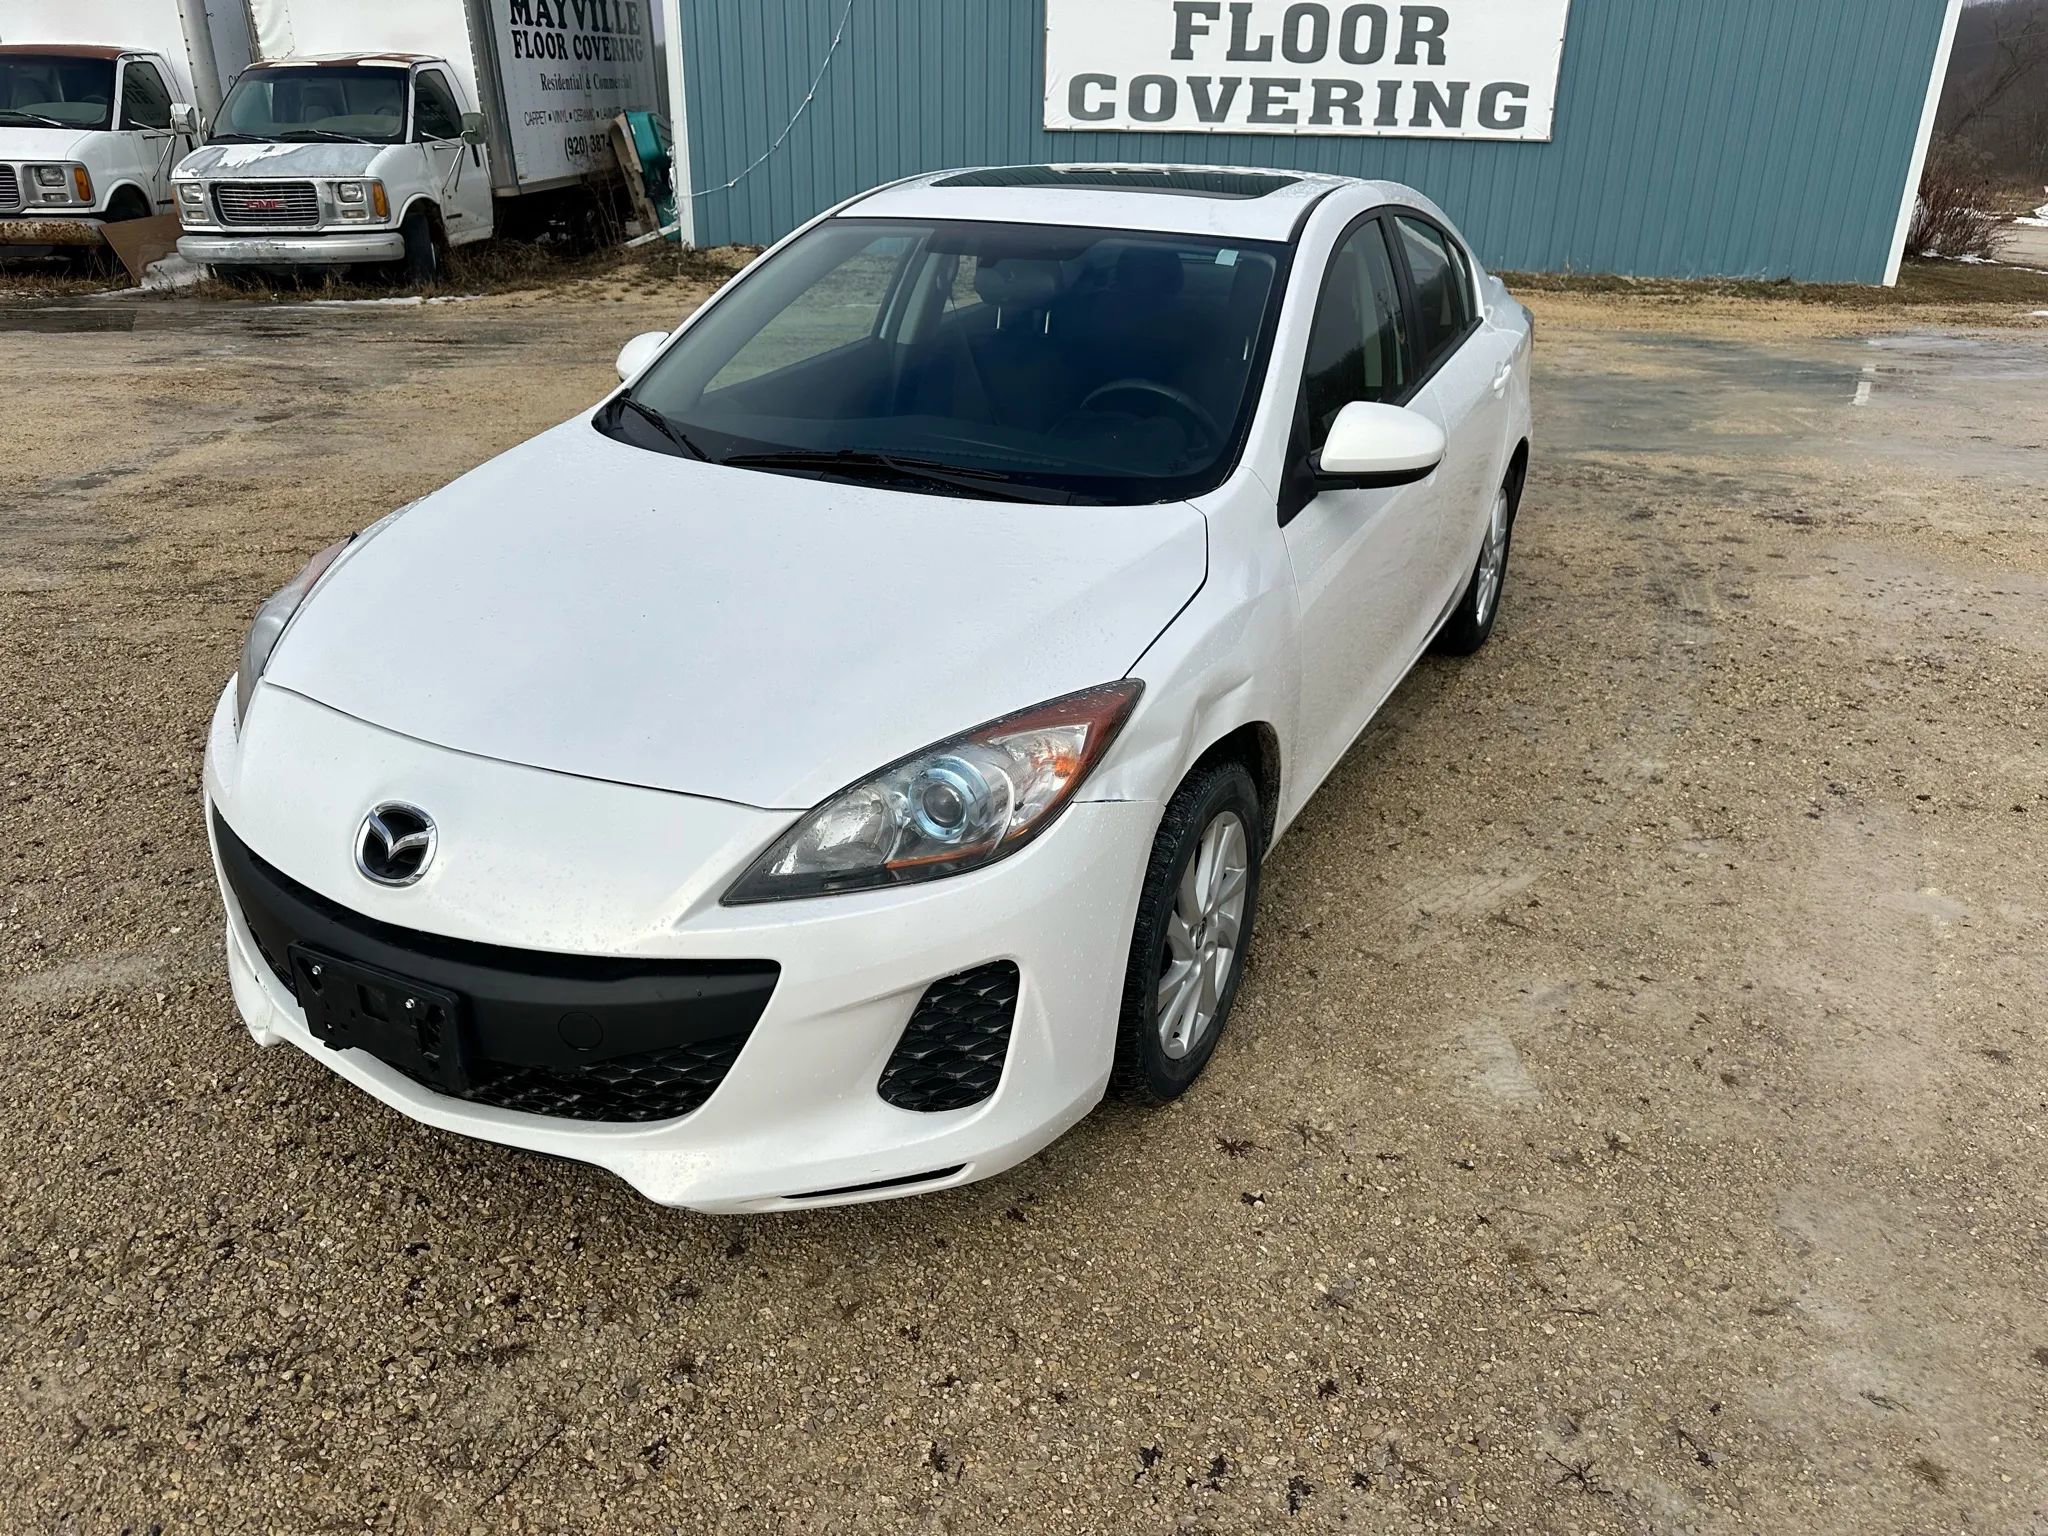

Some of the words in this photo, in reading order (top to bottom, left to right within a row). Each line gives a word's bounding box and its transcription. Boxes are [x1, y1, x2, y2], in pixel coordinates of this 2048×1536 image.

[510, 0, 641, 35] MAYVILLE
[1170, 1, 1449, 65] FLOOR
[511, 29, 569, 60] FLOOR
[573, 34, 643, 62] COVERING
[540, 73, 583, 91] Residential
[585, 73, 592, 90] &
[524, 110, 547, 126] CARPET
[1068, 73, 1530, 130] COVERING
[564, 135, 589, 161] (920)
